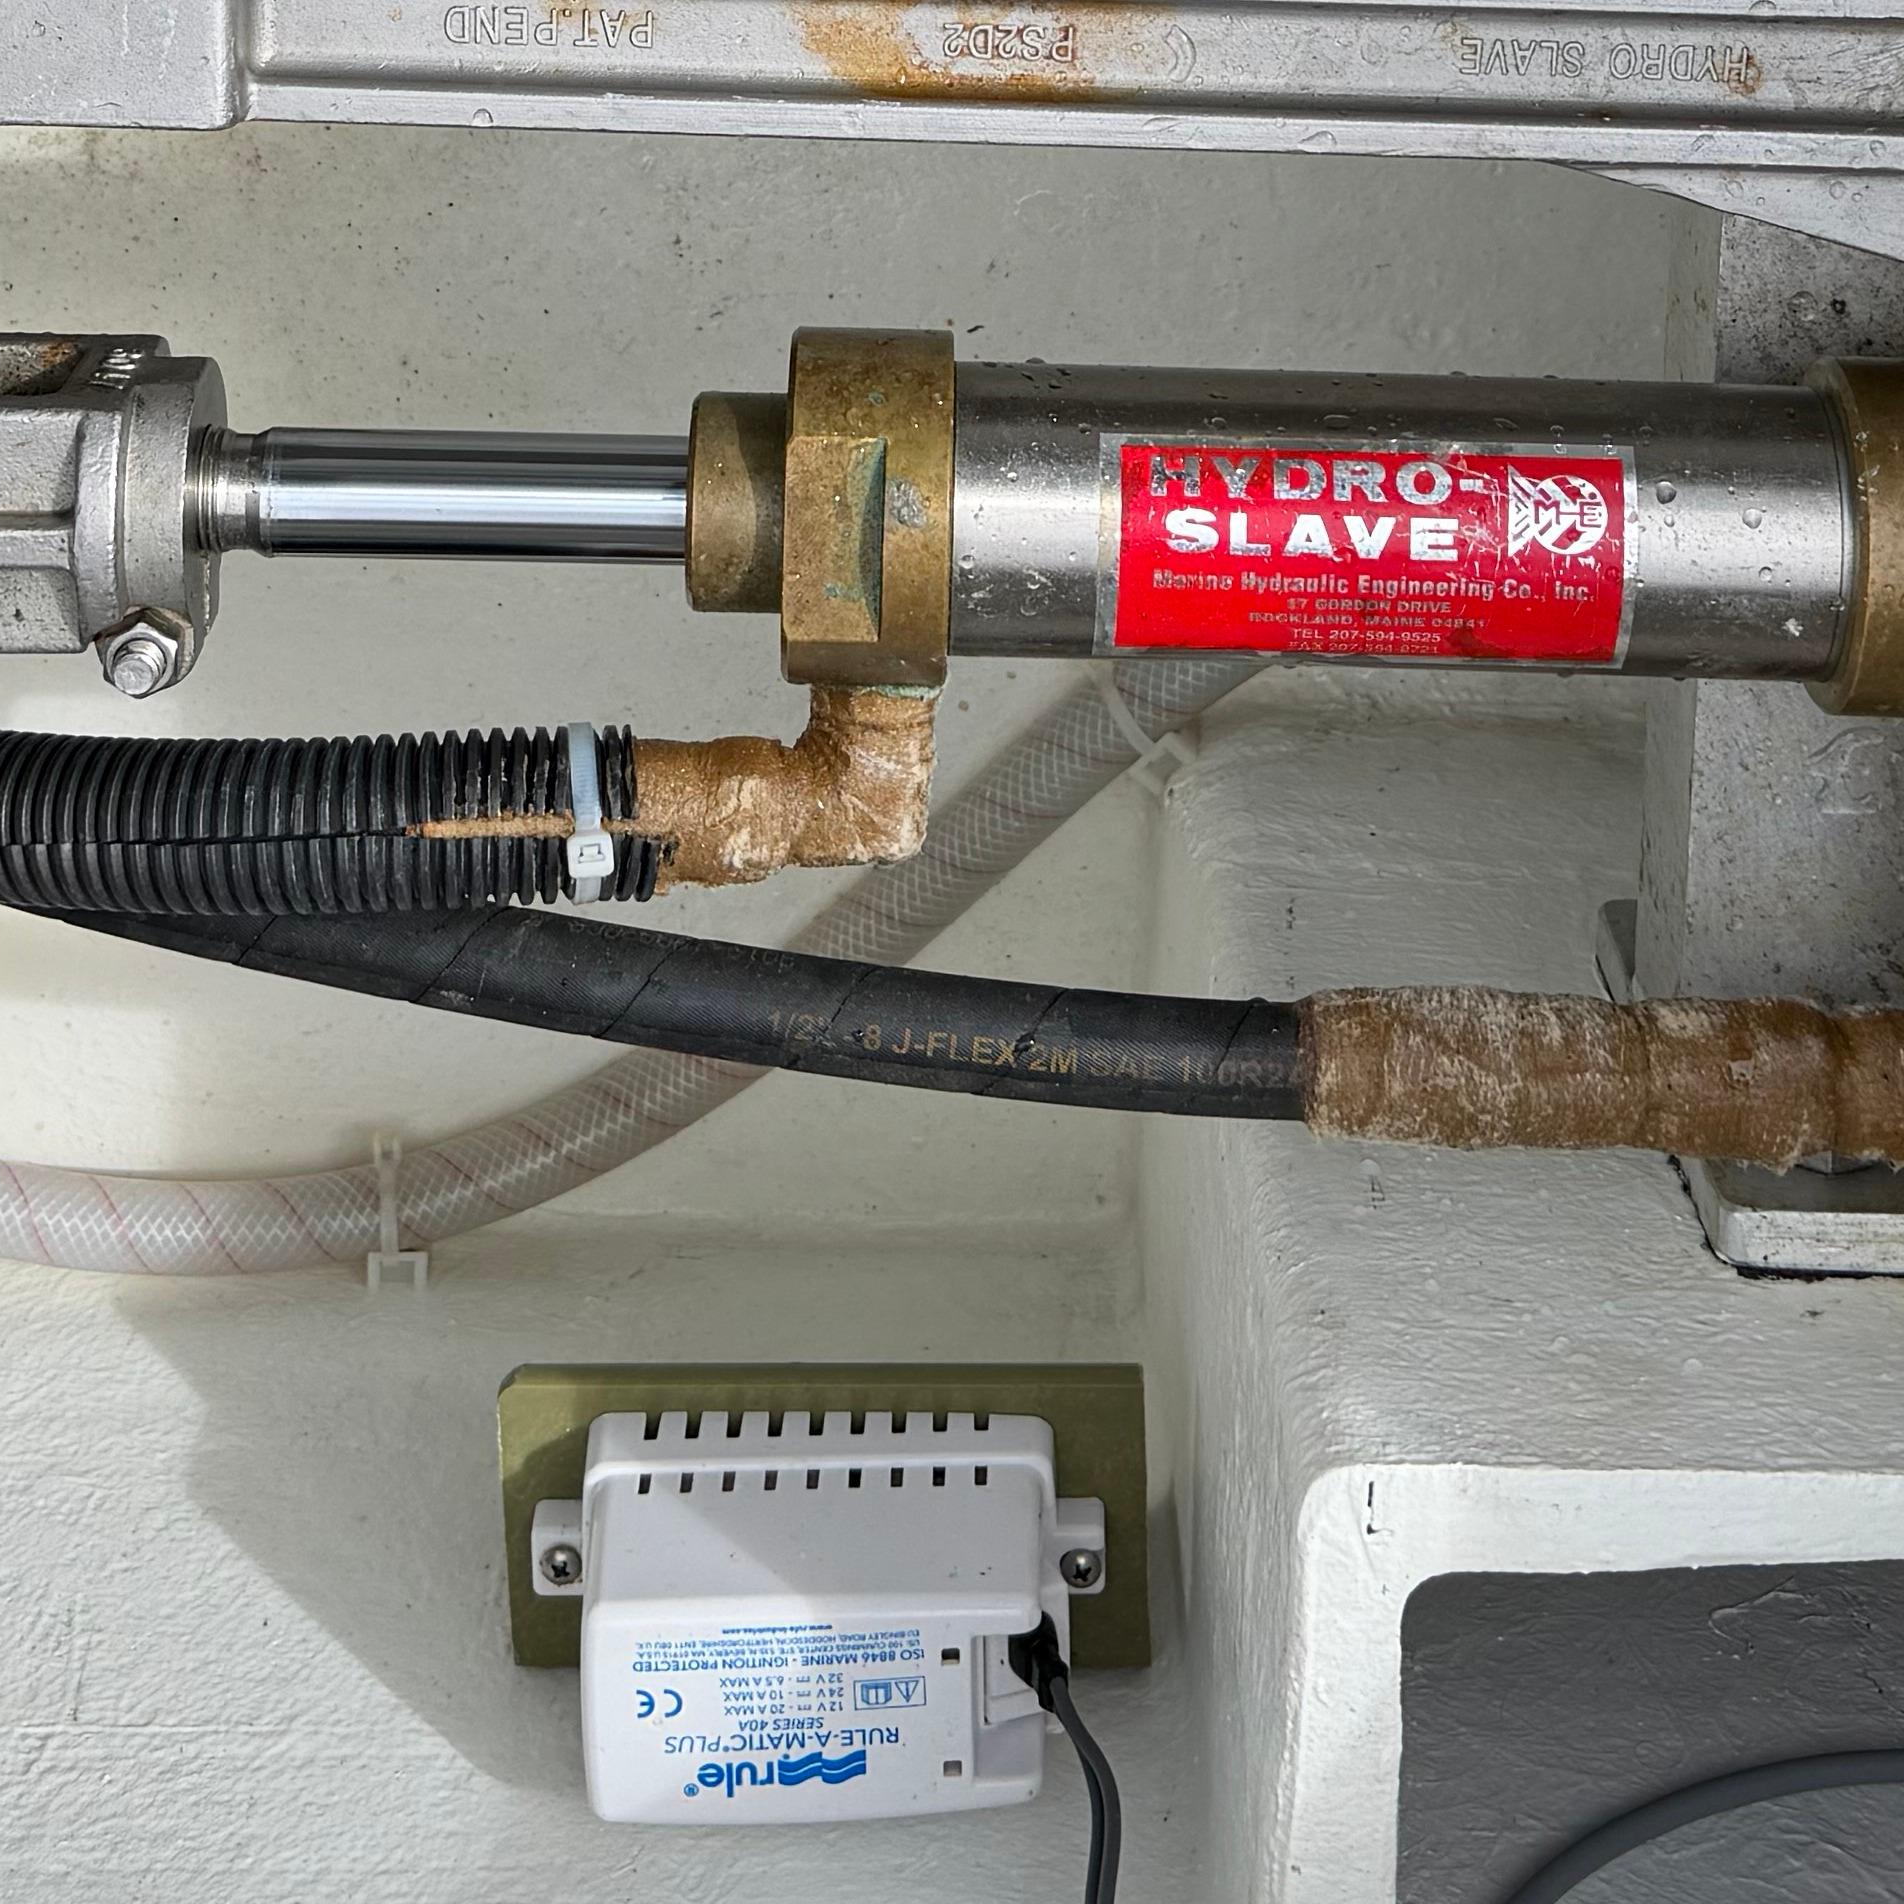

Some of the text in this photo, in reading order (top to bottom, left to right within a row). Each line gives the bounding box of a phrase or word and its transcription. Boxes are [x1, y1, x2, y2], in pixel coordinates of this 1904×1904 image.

[943, 23, 1075, 64] PS2D2
[1459, 38, 1749, 83] HYDRO SLAVE
[1150, 455, 1483, 505] HYDRO-
[1164, 506, 1459, 561] SLAVE
[1240, 571, 1349, 595] Hydraulic
[1358, 575, 1496, 601] Engineering
[1397, 600, 1452, 615] DRIVE
[1365, 615, 1427, 628] MAINE
[1329, 629, 1442, 644] 207-594-9525
[633, 1648, 924, 1672] ISO 8846 MARINE IGNITION PROTECTED
[719, 1678, 749, 1688] MAX
[723, 1691, 753, 1702] MAX
[724, 1705, 755, 1716] MAX
[738, 1717, 824, 1732] SERIES 40A
[664, 1736, 721, 1753] PLUS
